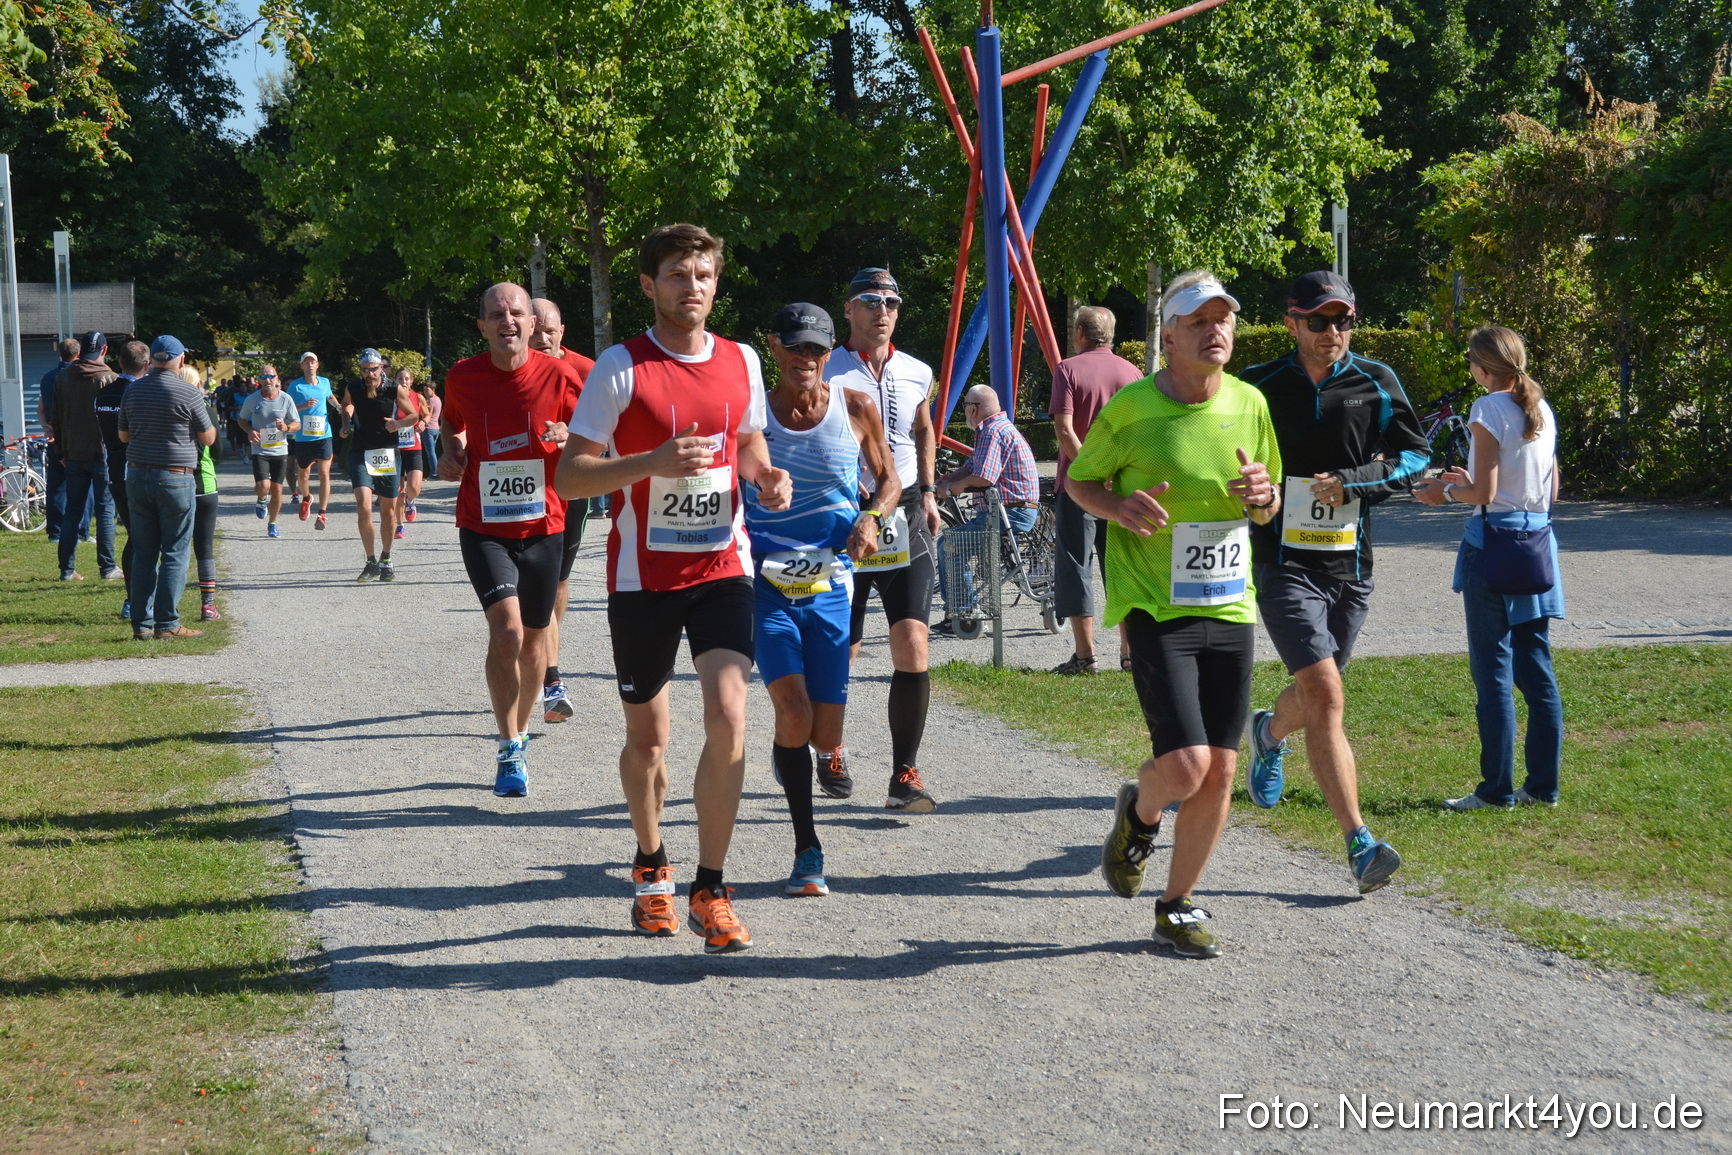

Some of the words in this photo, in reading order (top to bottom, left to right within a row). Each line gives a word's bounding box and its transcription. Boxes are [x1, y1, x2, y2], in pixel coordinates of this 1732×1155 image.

[308, 421, 321, 429] 133
[267, 433, 277, 441] 22
[372, 455, 389, 465] 309
[496, 465, 525, 474] BOCK
[488, 476, 536, 497] 2466
[676, 476, 712, 488] BOCK
[662, 491, 721, 518] 2459
[1310, 499, 1335, 521] 61
[495, 506, 532, 516] Johannes
[676, 531, 709, 543] Tobias
[1199, 528, 1233, 539] BOCK
[1299, 531, 1344, 543] Schorschi
[857, 555, 898, 566] Peter-Paul
[1185, 543, 1241, 571] 2512
[781, 559, 823, 578] 224
[1203, 584, 1226, 596] Erich
